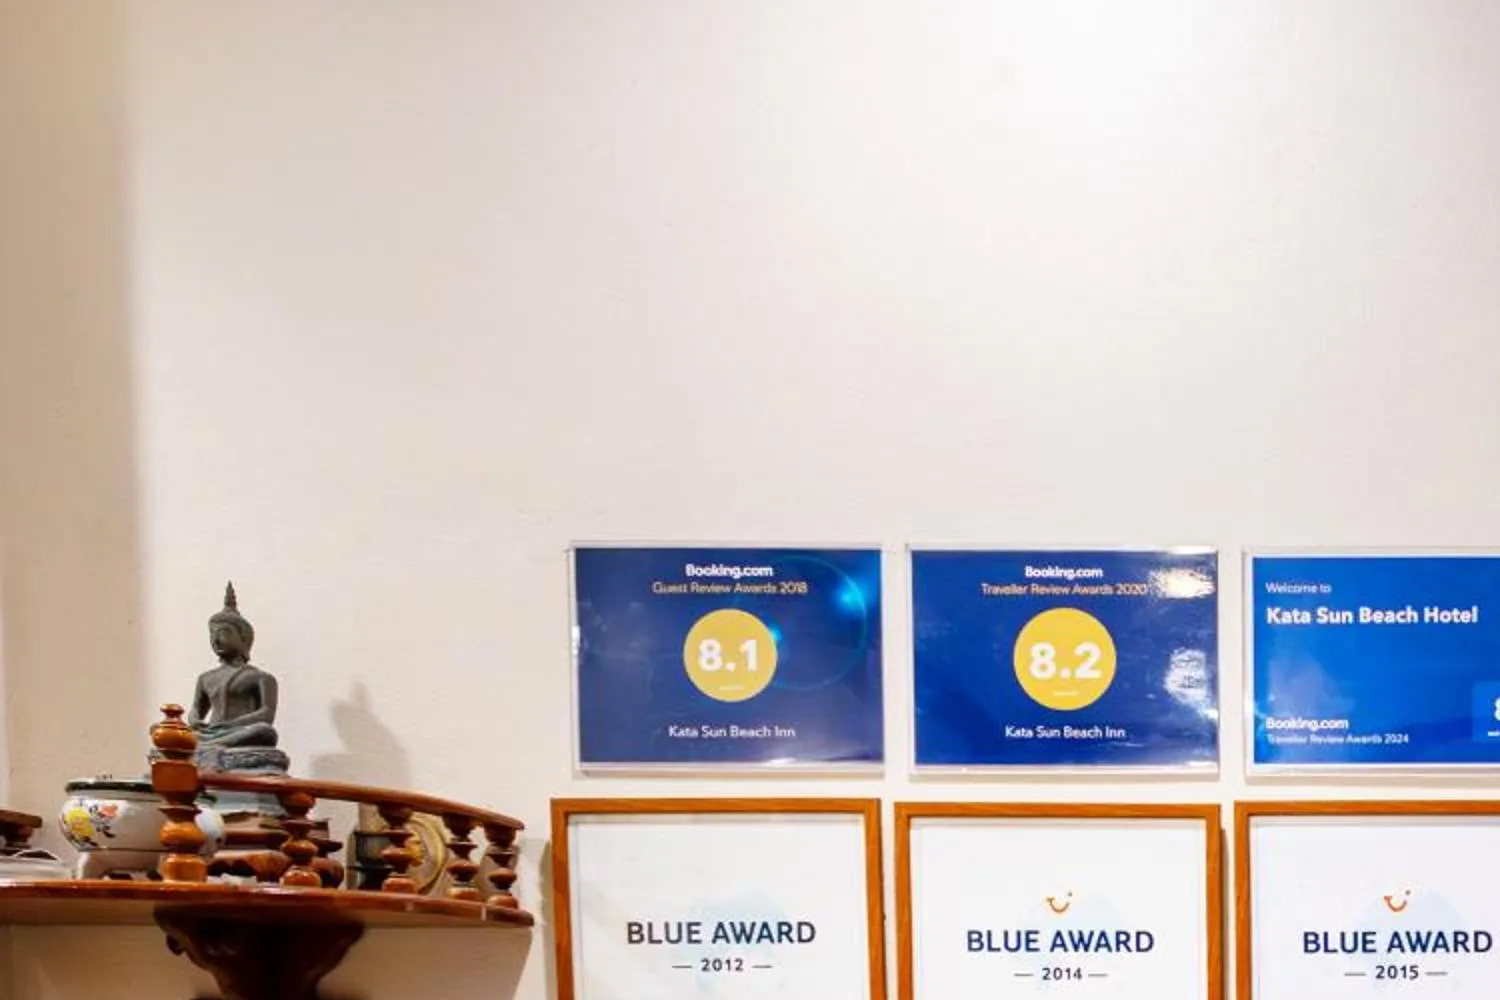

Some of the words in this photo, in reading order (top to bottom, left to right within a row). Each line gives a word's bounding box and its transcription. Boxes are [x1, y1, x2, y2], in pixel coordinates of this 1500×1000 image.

[686, 564, 773, 579] Booking.com
[1025, 566, 1103, 580] Booking.com
[652, 582, 689, 594] Guest
[691, 582, 731, 594] Review
[733, 582, 777, 594] Awards
[779, 582, 808, 594] 2018
[981, 583, 1029, 595] Traveller
[1032, 583, 1071, 595] Review
[1073, 583, 1114, 595] Awards
[1116, 583, 1148, 595] 2020
[1265, 582, 1318, 594] Welcome
[1320, 582, 1332, 594] to
[1267, 606, 1311, 625] Kata
[1316, 606, 1353, 625] Sun
[1359, 606, 1419, 625] Beach
[1424, 606, 1479, 625] Hotel
[698, 639, 758, 672] 8.1
[1029, 642, 1102, 680] 8.2
[1265, 717, 1349, 731] Booking.com
[669, 726, 698, 738] Kata
[701, 726, 727, 738] Sun
[730, 726, 772, 738] Beach
[774, 726, 796, 738] Inn
[1005, 726, 1033, 739] Kata
[1036, 726, 1061, 739] Sun
[1064, 726, 1103, 739] Beach
[1105, 726, 1126, 739] Inn
[627, 921, 702, 945] BLUE
[711, 921, 817, 945] AWARD
[967, 930, 1040, 953] BLUE
[1050, 930, 1155, 953] AWARD
[1303, 931, 1377, 954] BLUE
[1387, 931, 1493, 954] AWARD
[700, 958, 744, 972] 2012
[1042, 967, 1083, 981] 2014
[1375, 965, 1420, 980] 2015
